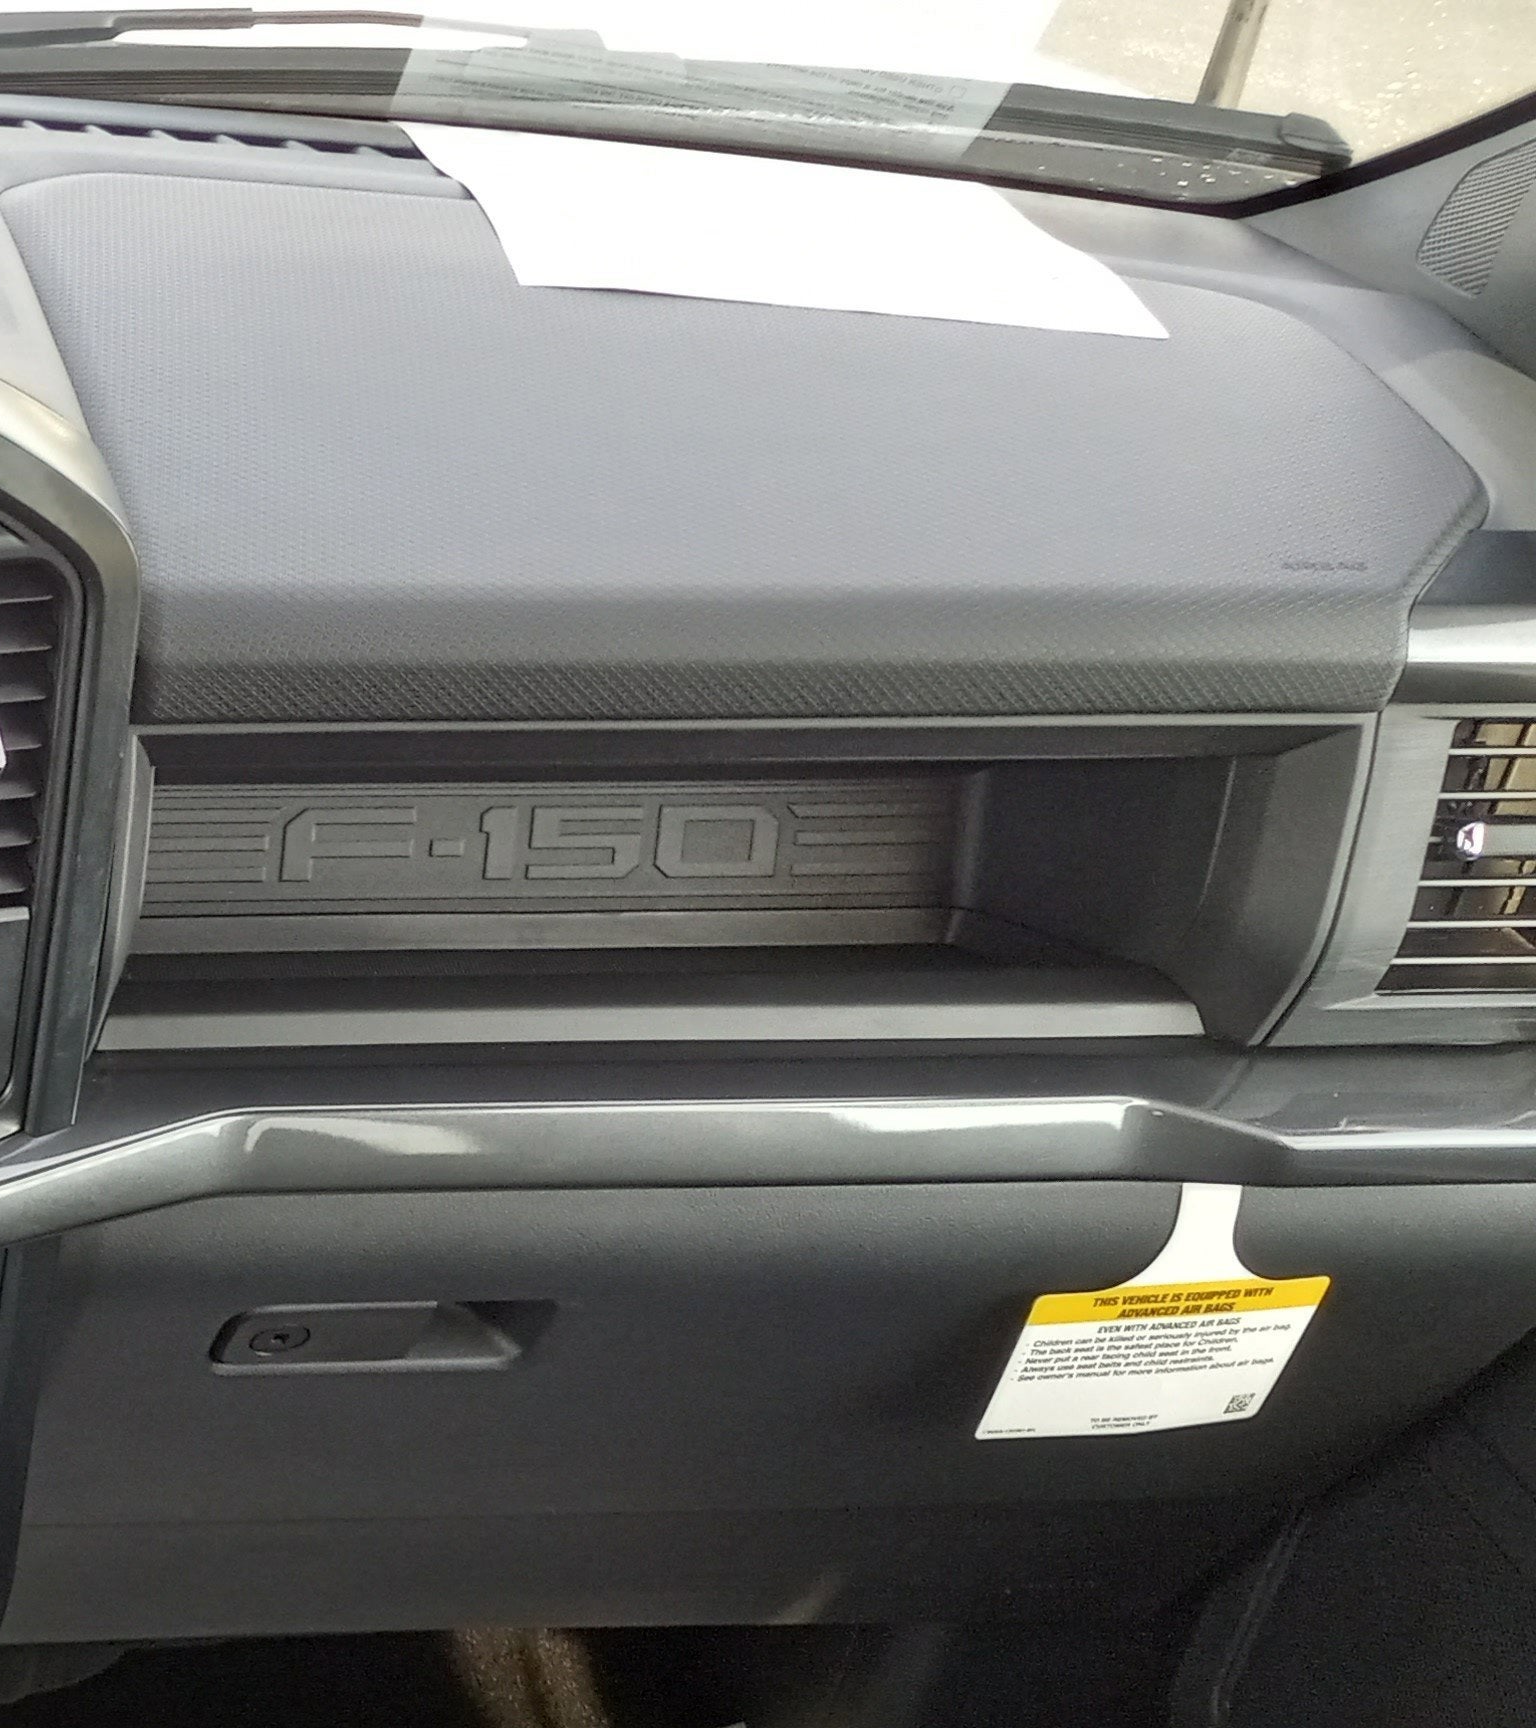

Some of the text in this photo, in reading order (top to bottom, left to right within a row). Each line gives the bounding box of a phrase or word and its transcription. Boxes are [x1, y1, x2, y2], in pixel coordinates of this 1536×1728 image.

[279, 804, 780, 883] F-150
[1093, 1287, 1274, 1307] THIS VEHICLE IS EQUIPPED WITH
[1117, 1302, 1235, 1319] ADVANCED AIR BAGS
[1097, 1317, 1241, 1334] EVEN WITH ADVANCED AIR BAGS
[1033, 1340, 1073, 1348] Children
